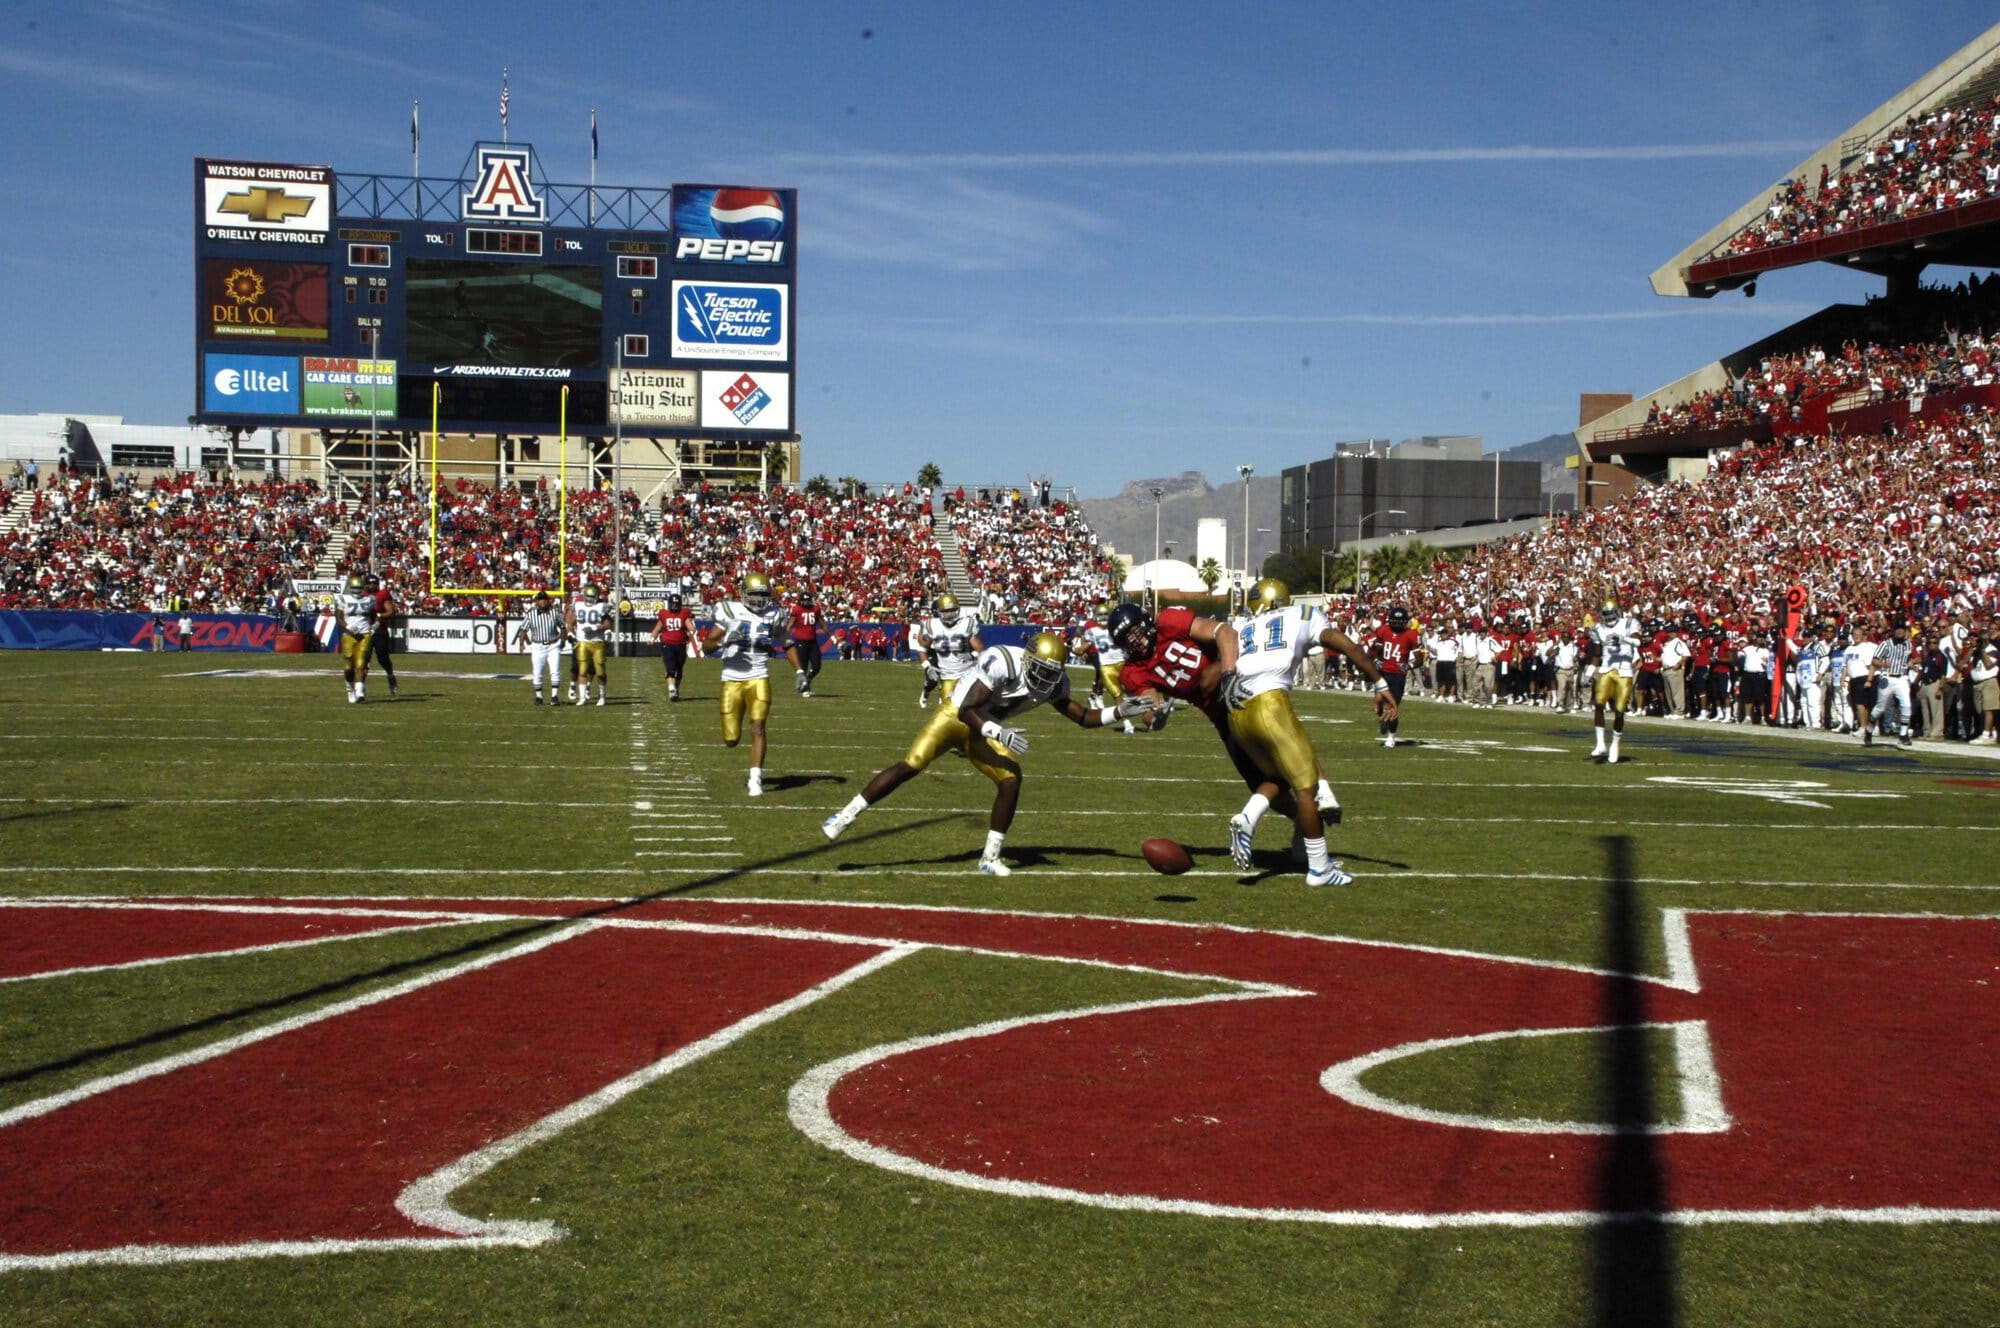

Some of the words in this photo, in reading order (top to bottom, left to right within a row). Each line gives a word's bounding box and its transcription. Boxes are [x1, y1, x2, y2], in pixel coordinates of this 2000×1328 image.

[208, 165, 255, 178] WATSON
[258, 168, 325, 181] CHEVROLET
[464, 149, 544, 221] A
[207, 228, 257, 240] O'RIELLY
[259, 231, 326, 244] CHEVROLET
[425, 234, 444, 244] TOL
[565, 241, 583, 250] TOL
[676, 237, 784, 263] PEPSI
[369, 277, 377, 286] TO
[378, 278, 387, 286] GO
[631, 289, 643, 297] QTR
[704, 292, 757, 309] Tucson
[213, 305, 242, 323] DEL
[248, 306, 277, 324] SOL
[358, 318, 371, 326] BALL
[372, 318, 381, 326] ON
[709, 308, 772, 323] Electric
[715, 322, 771, 337] Power
[722, 348, 746, 356] Energy
[748, 348, 780, 357] Company
[305, 357, 358, 373] BRAKE
[451, 365, 572, 378] ARIZONAATHLETICS.COM
[306, 373, 325, 383] CAR
[328, 374, 352, 384] CARE
[620, 371, 686, 388] Arizona
[659, 390, 696, 406] Star
[635, 412, 666, 421] Tucson
[666, 618, 681, 631] 50
[802, 612, 815, 625] 76
[410, 628, 445, 639] MUSCLE
[447, 628, 468, 639] MILK
[1240, 616, 1287, 654] 11
[1383, 641, 1401, 662] 84
